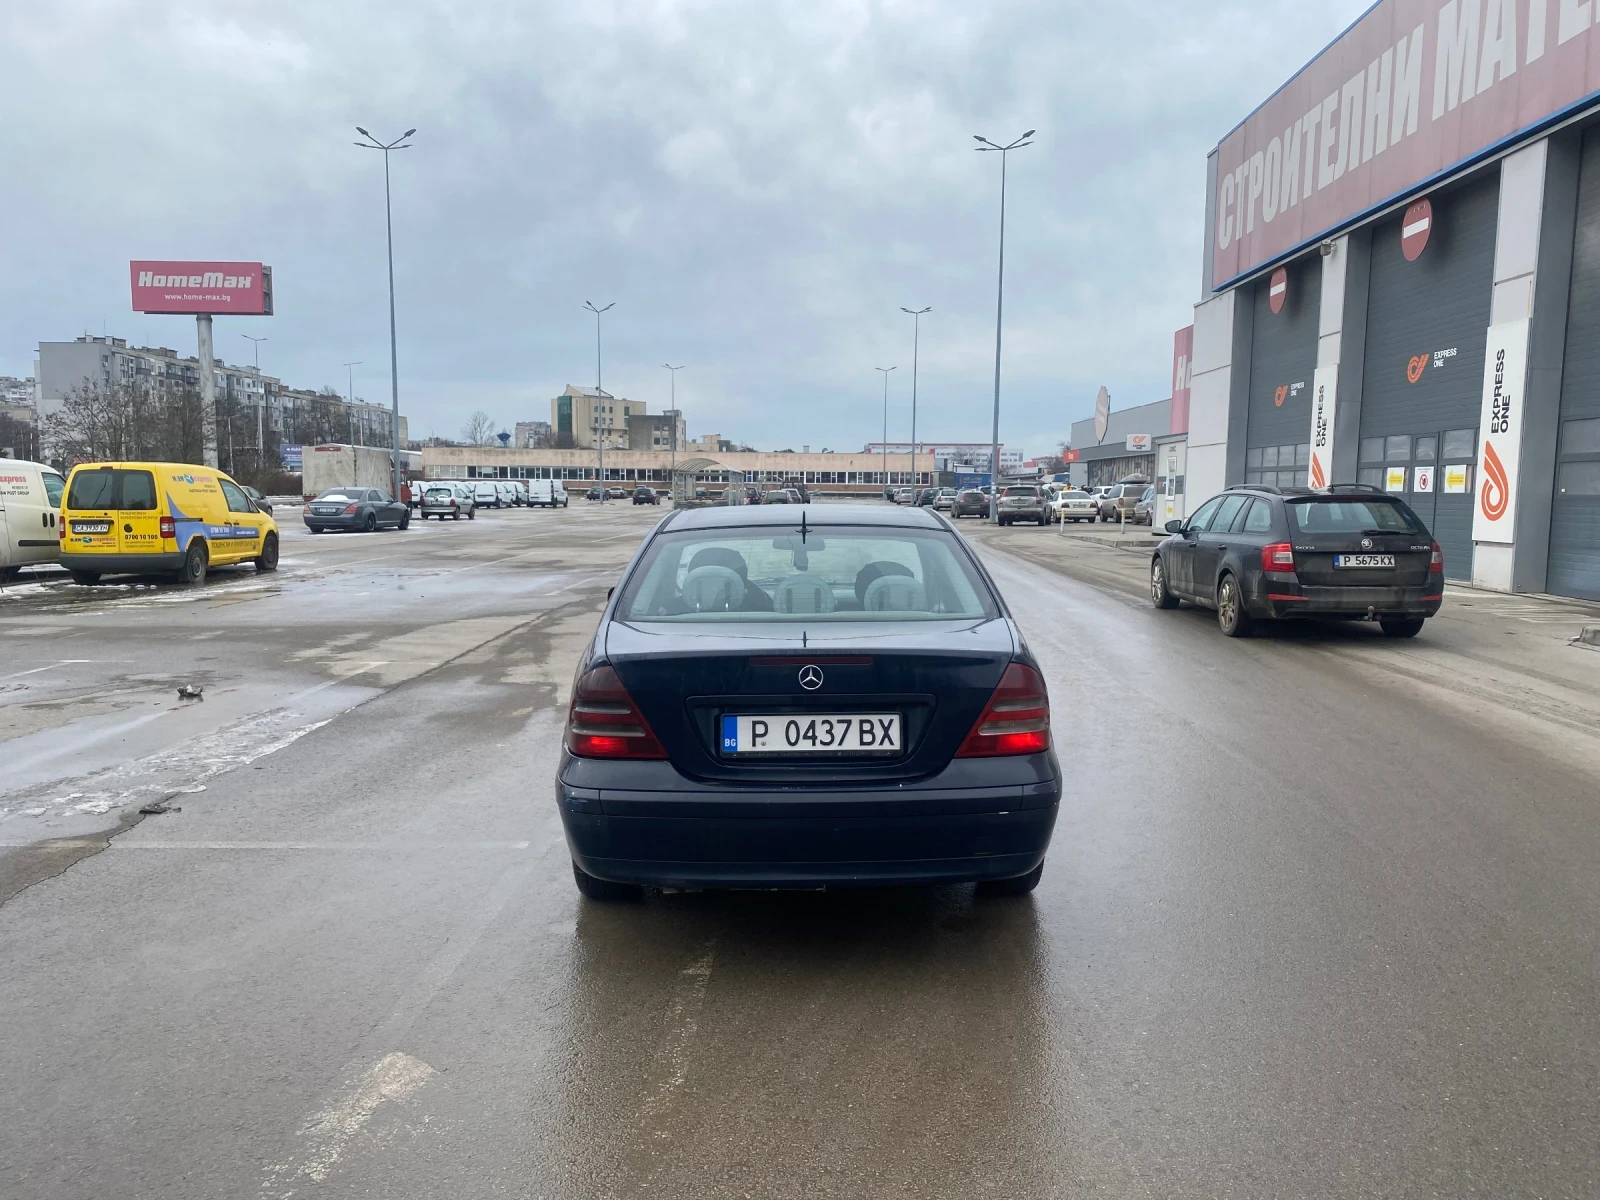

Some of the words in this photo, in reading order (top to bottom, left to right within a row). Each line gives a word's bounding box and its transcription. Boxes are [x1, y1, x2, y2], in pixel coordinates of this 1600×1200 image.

[1218, 22, 1424, 250] СТРОИТЕЛНИ
[138, 271, 252, 288] HomeMax
[164, 293, 231, 302] www.home-max.bg
[1433, 347, 1458, 360] EXPRESS
[1433, 359, 1444, 368] ONE
[1290, 381, 1305, 390] EXPRESS
[1490, 348, 1505, 434] EXPRESS
[1315, 384, 1325, 447] EXPRESS
[1500, 394, 1511, 434] ONE
[1343, 555, 1351, 566] P
[1355, 555, 1379, 566] 5675
[1380, 555, 1394, 566] KX
[751, 719, 769, 748] P
[785, 719, 852, 747] 0437
[859, 718, 895, 746] BX
[724, 738, 737, 747] BG
